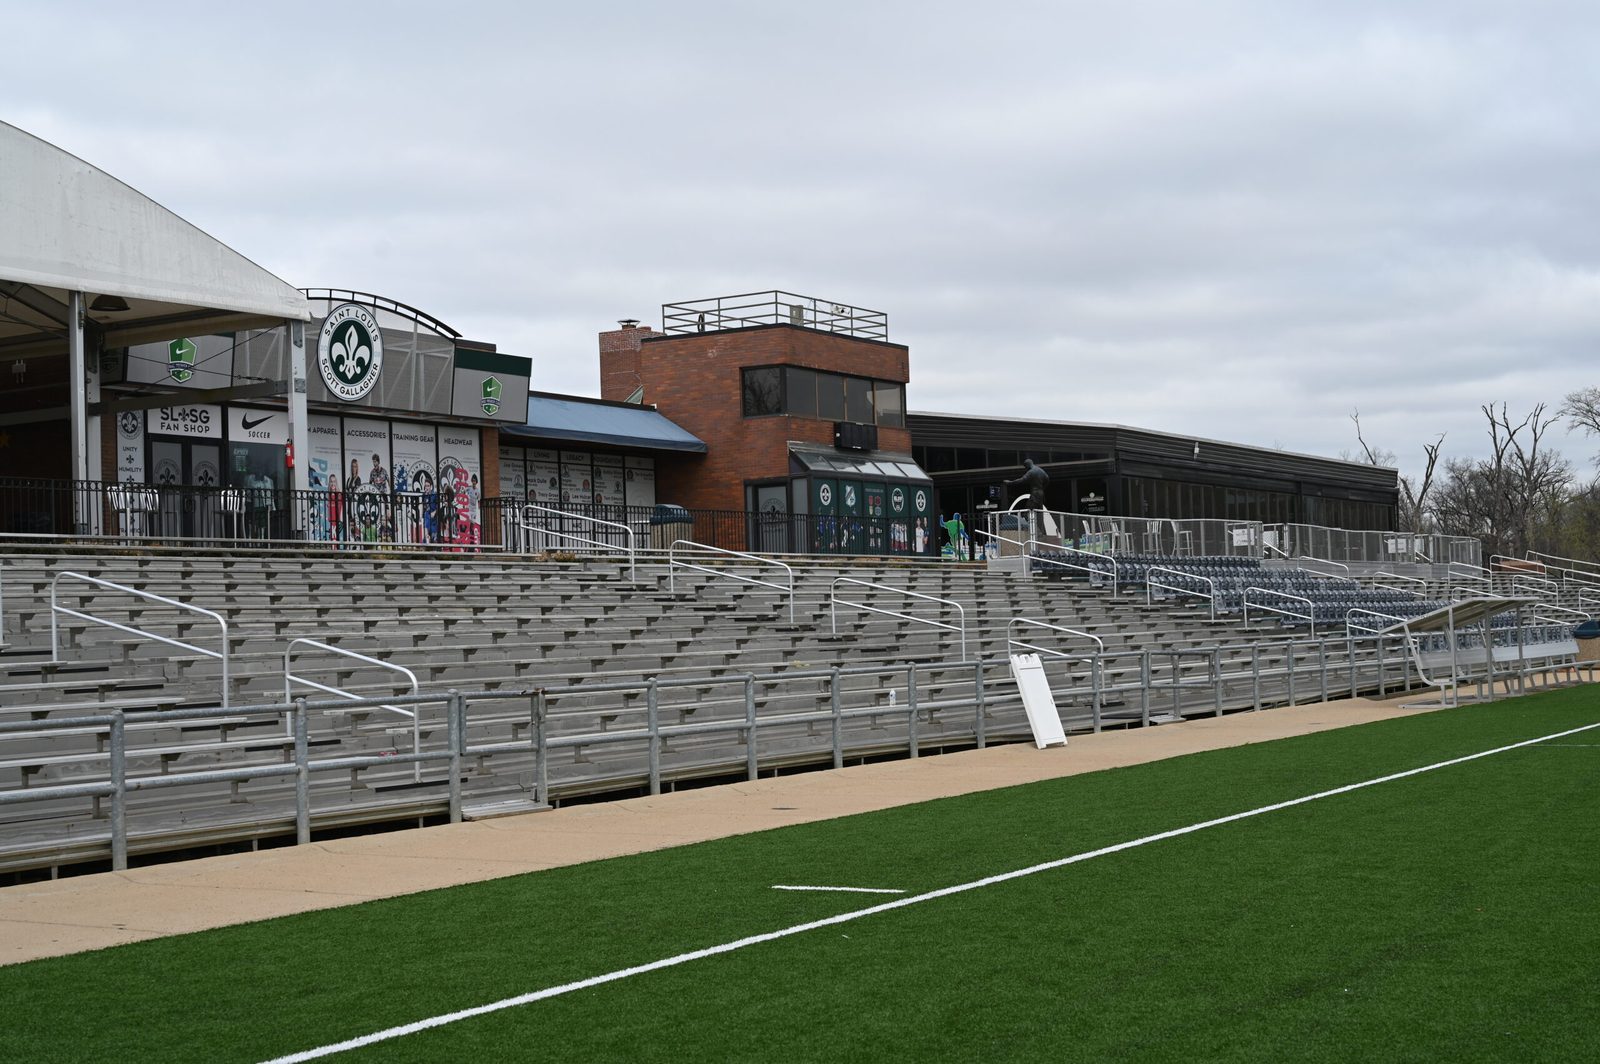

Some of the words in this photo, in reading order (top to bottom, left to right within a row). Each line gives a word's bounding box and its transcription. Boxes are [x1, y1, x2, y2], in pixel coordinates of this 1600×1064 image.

[325, 309, 350, 336] SAINT
[355, 310, 379, 342] LOUIS
[322, 358, 339, 389] SCOTT
[340, 363, 379, 396] GALLAGHER
[160, 423, 180, 432] FAN
[184, 424, 210, 434] SHOP
[312, 427, 338, 435] APPAREL
[248, 430, 271, 439] SOCCER
[347, 429, 387, 439] ACCESSORIES
[393, 433, 418, 442] TRAINING
[420, 435, 434, 443] GEAR
[444, 438, 472, 446] HEADWEAR
